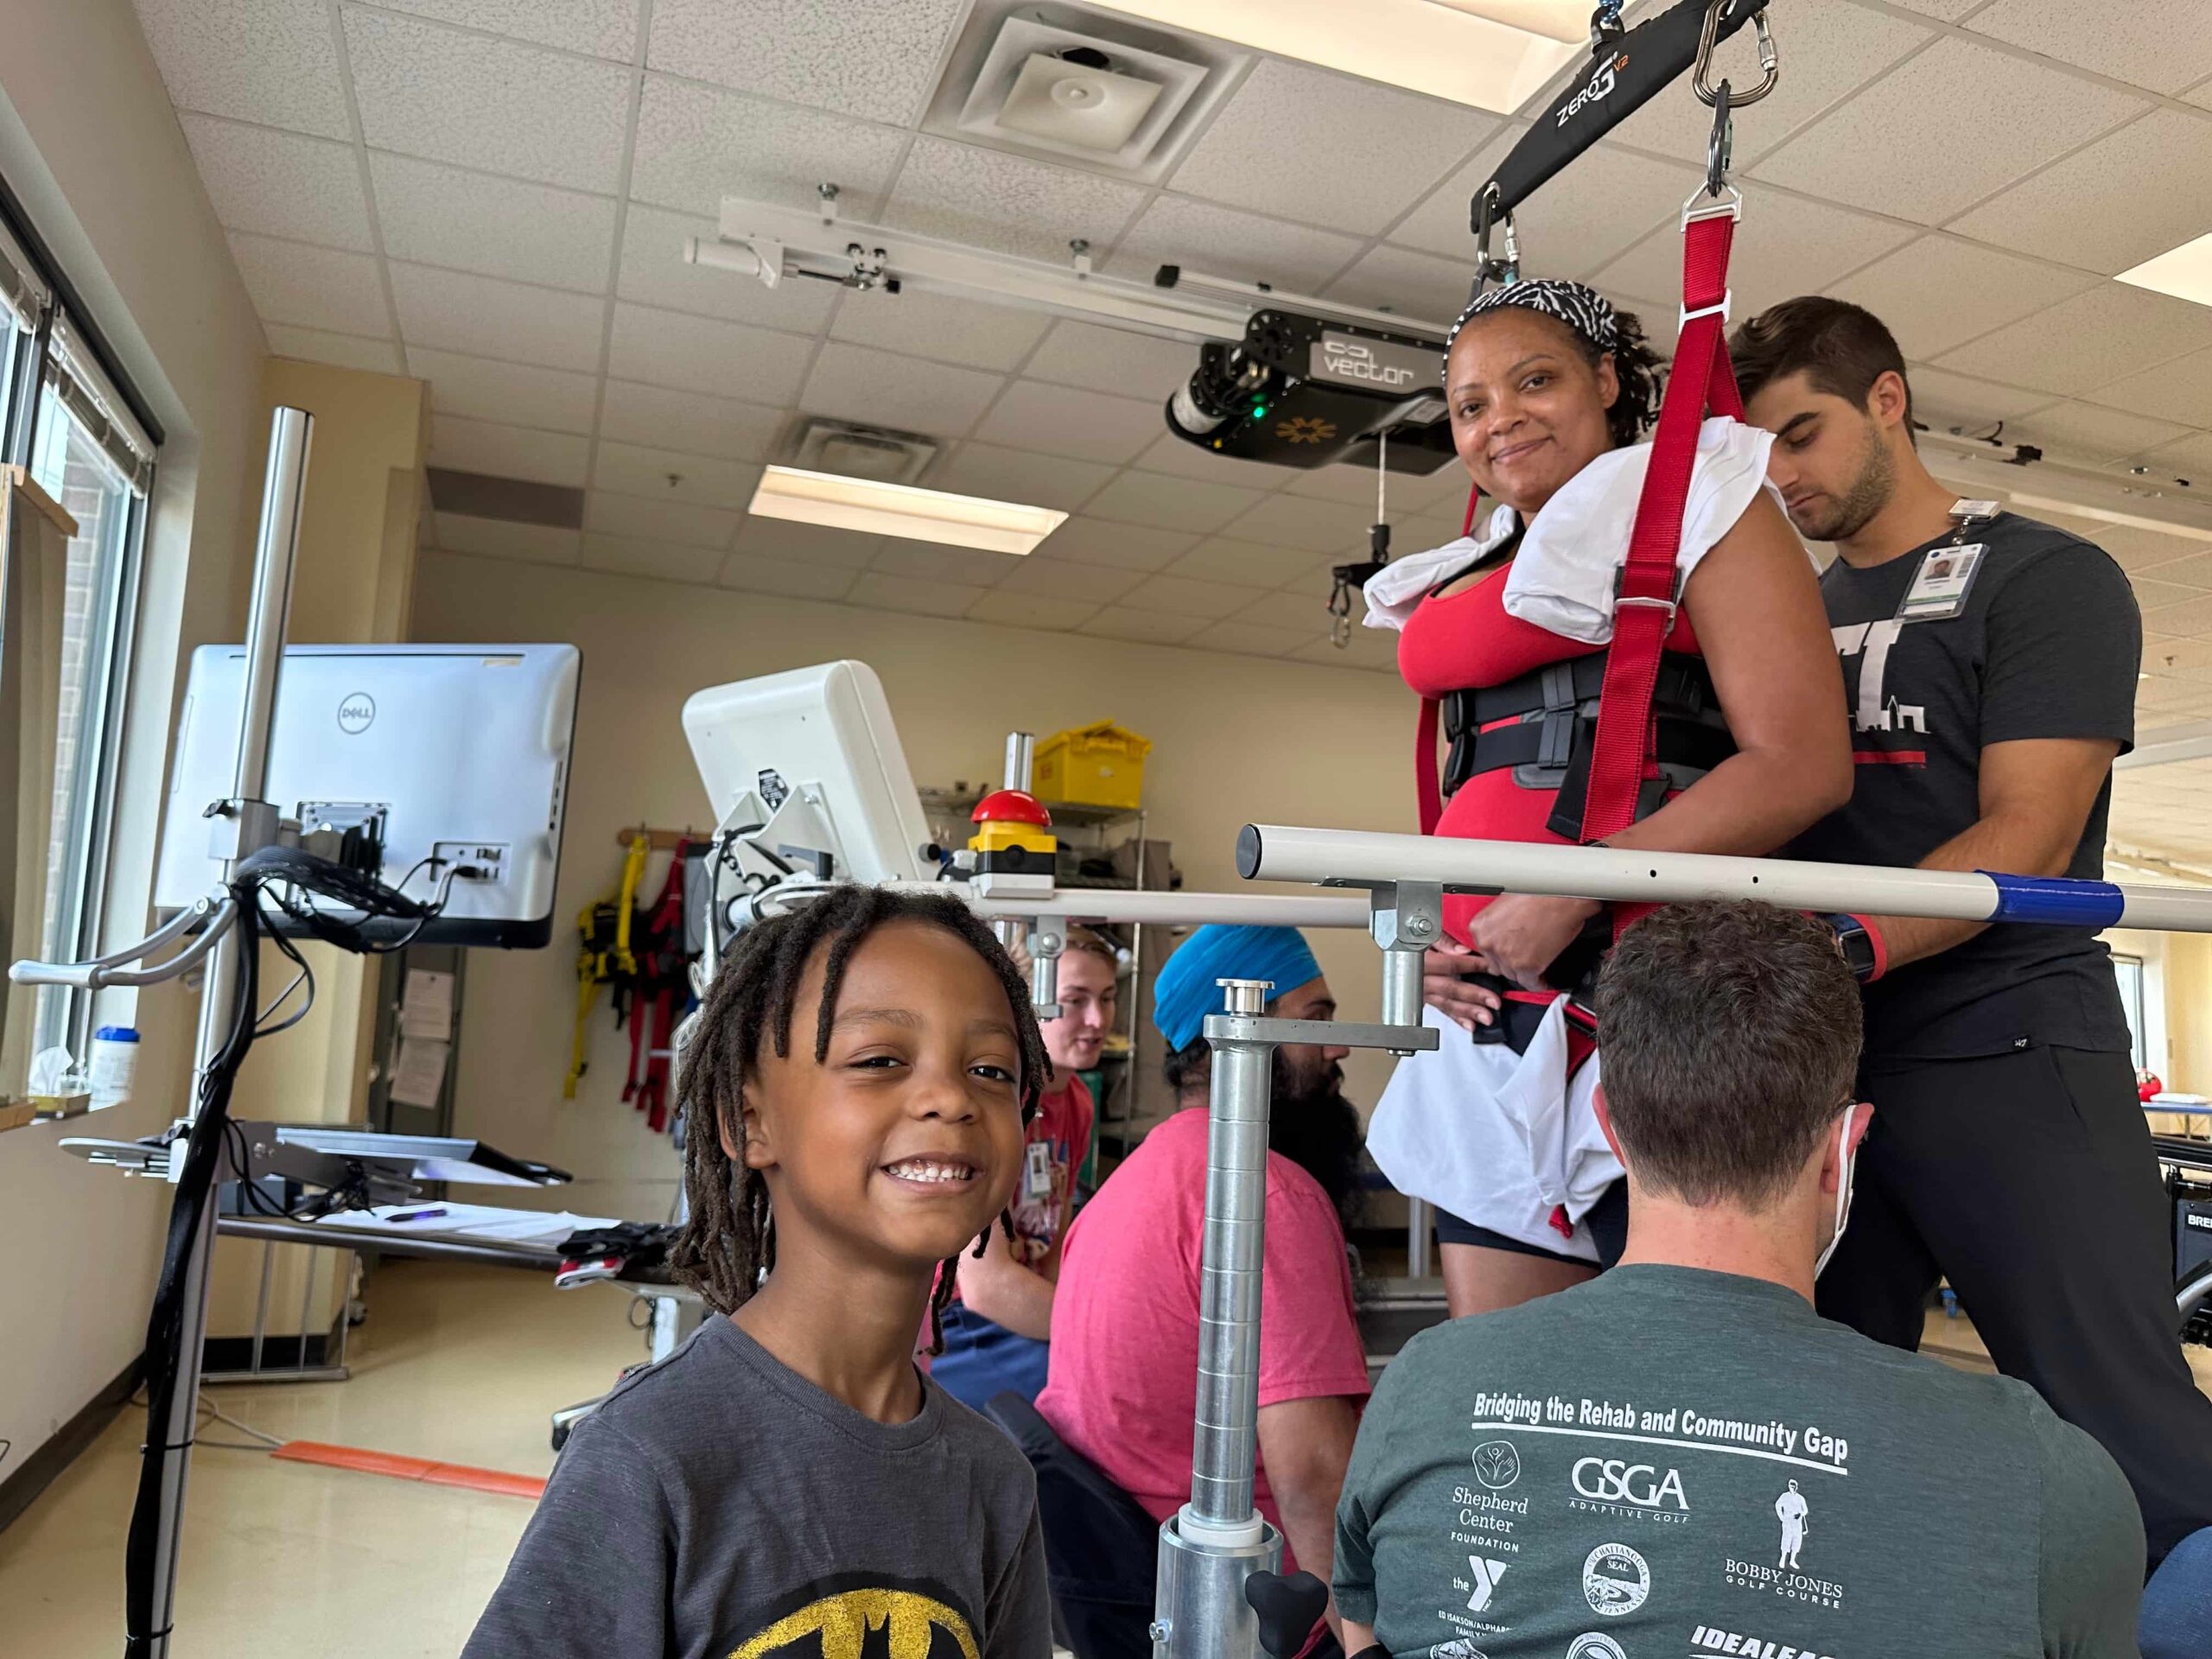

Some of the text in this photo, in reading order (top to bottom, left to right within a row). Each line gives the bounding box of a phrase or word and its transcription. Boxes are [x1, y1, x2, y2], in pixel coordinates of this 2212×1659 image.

[1324, 352, 1414, 385] vector
[342, 707, 371, 718] DELL
[2188, 1214, 2212, 1229] BRE
[1473, 1392, 1848, 1465] Bridging the Rehab and Community Gap
[1571, 1457, 1690, 1510] GSGA
[1452, 1486, 1529, 1514] Shepherd
[1569, 1500, 1689, 1524] ADAPTIVE GOLF
[1459, 1508, 1514, 1533] Center
[1451, 1531, 1519, 1553] FOUNDATION
[1607, 1560, 1629, 1572] SEAL
[1725, 1558, 1843, 1599] BOBBY JONES
[1452, 1576, 1469, 1592] the
[1726, 1574, 1840, 1609] GOLF COURSE
[1438, 1610, 1446, 1619] ED
[1691, 1625, 1836, 1659] IDEALE
